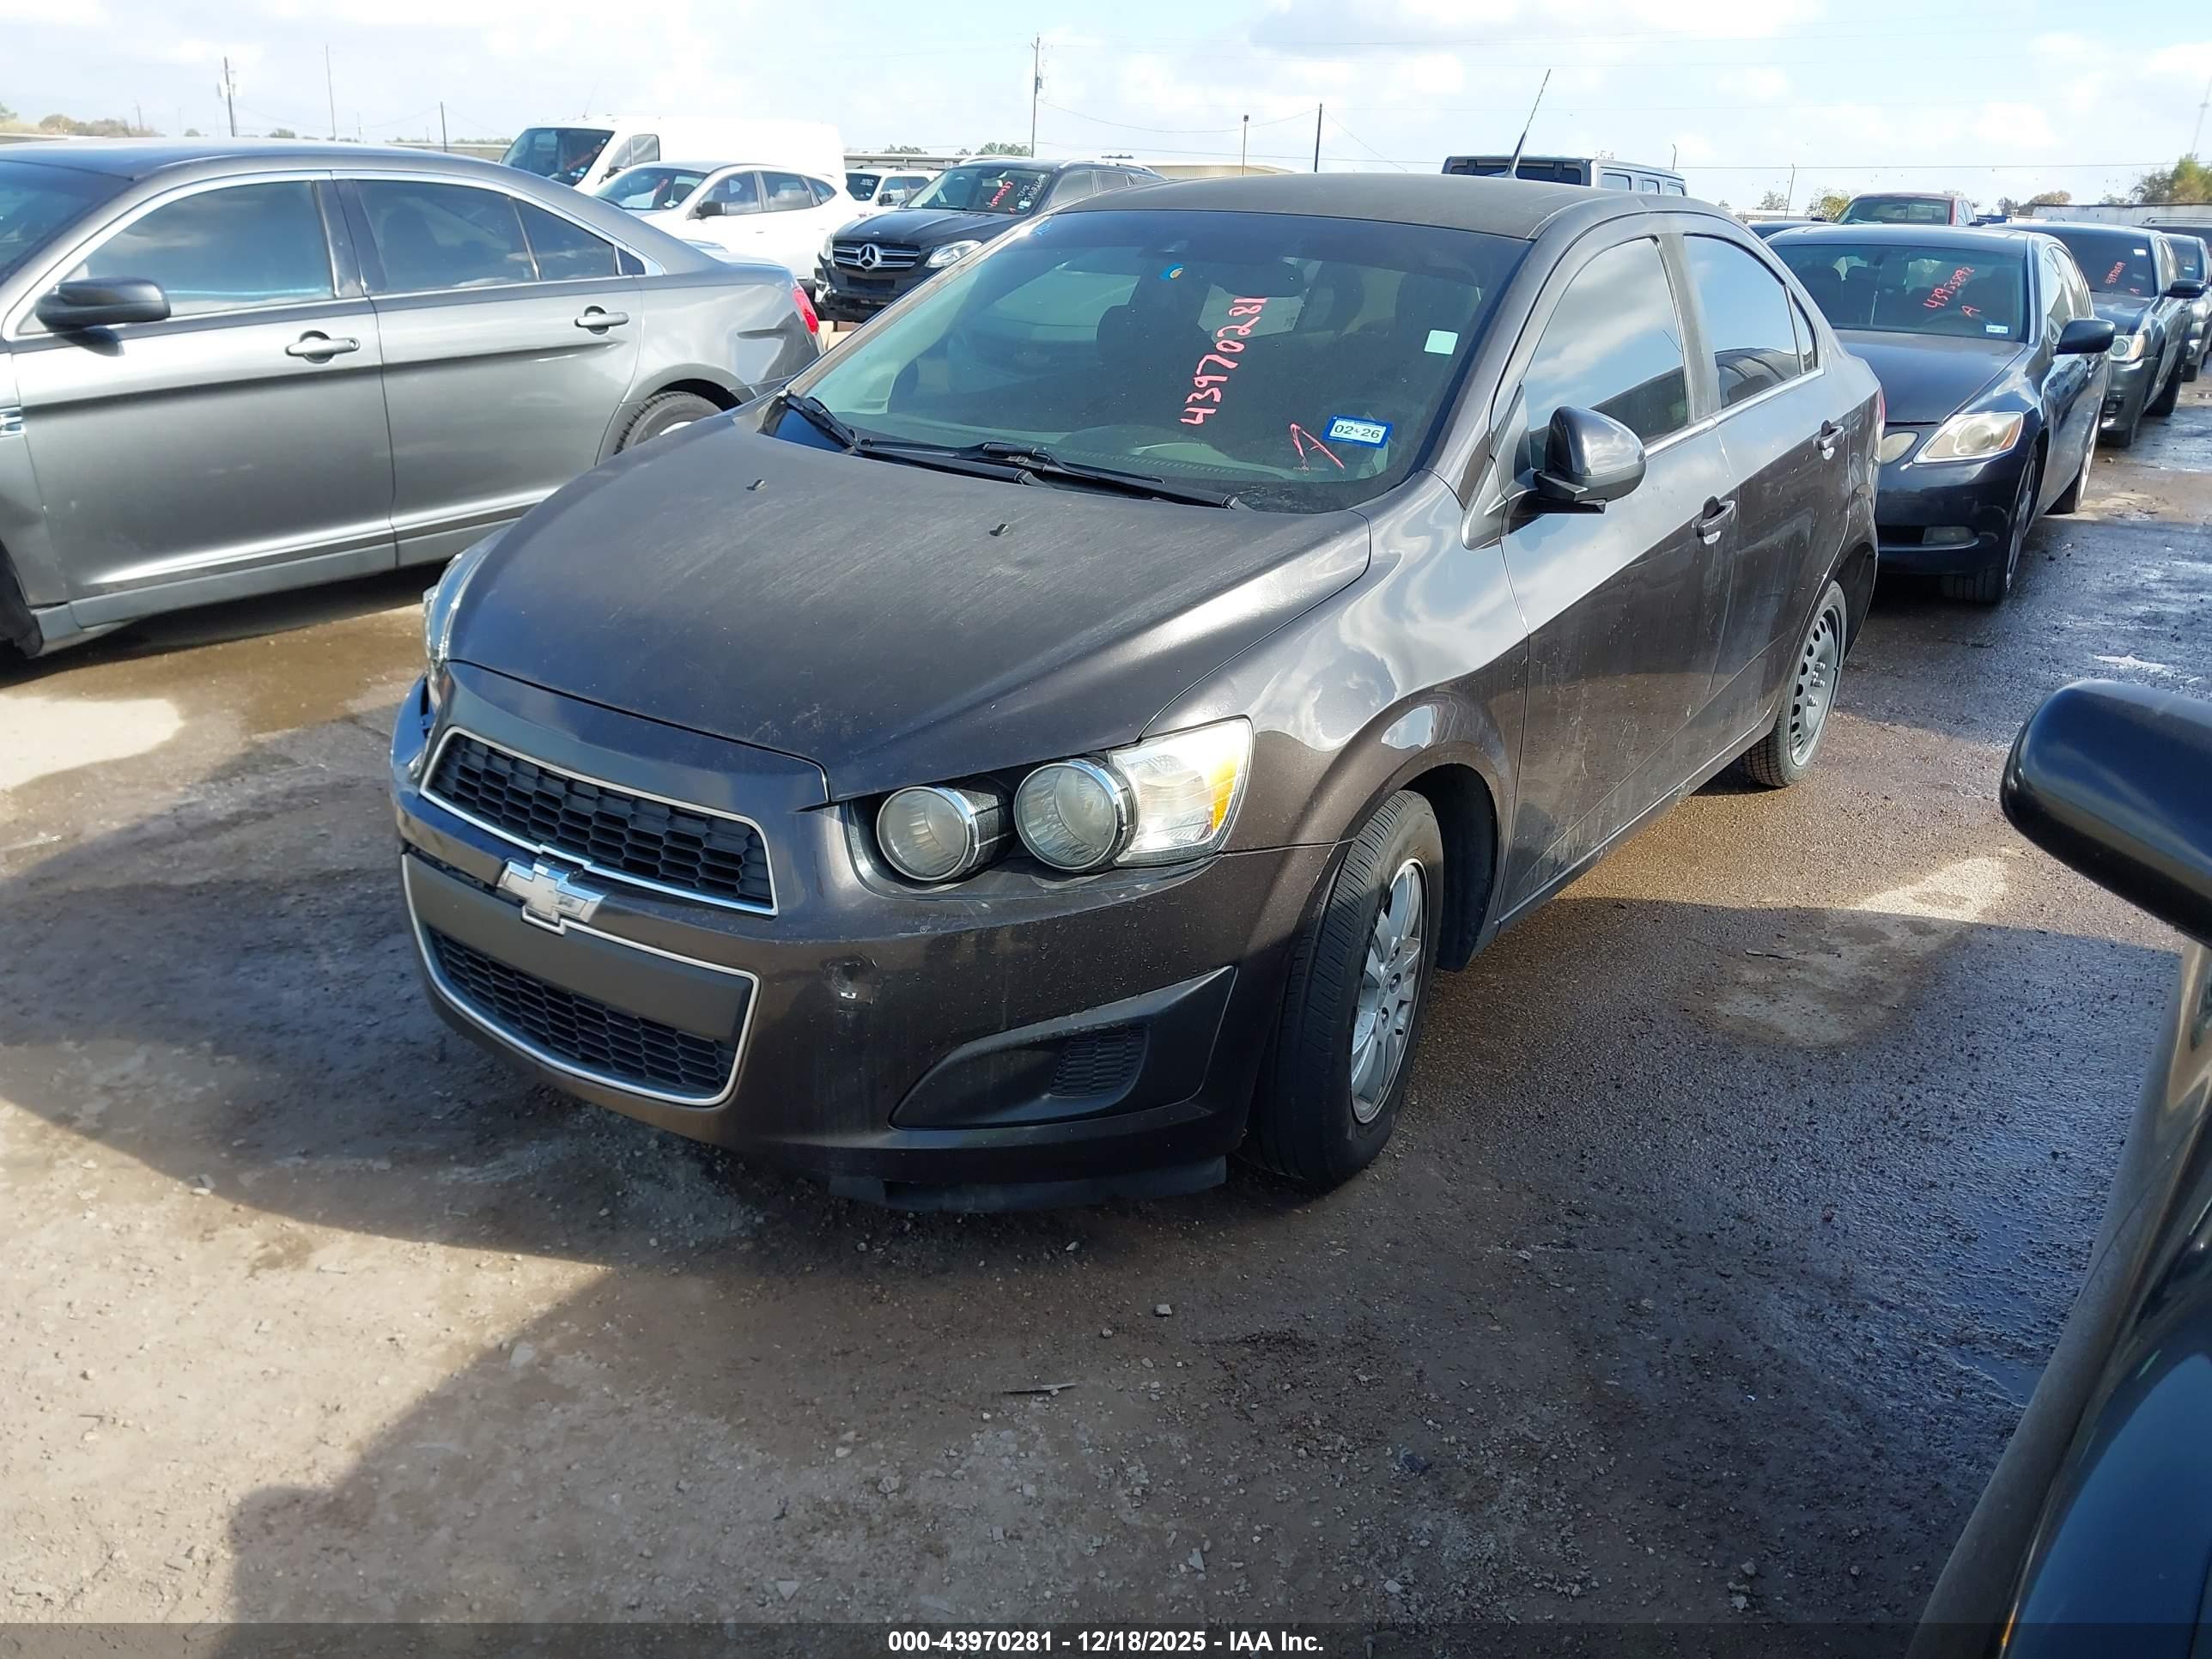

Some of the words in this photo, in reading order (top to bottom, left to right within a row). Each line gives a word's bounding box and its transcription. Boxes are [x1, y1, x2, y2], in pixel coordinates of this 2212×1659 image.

[1961, 305, 1982, 318] A
[1180, 297, 1268, 425] 43970281
[1290, 422, 1345, 471] A
